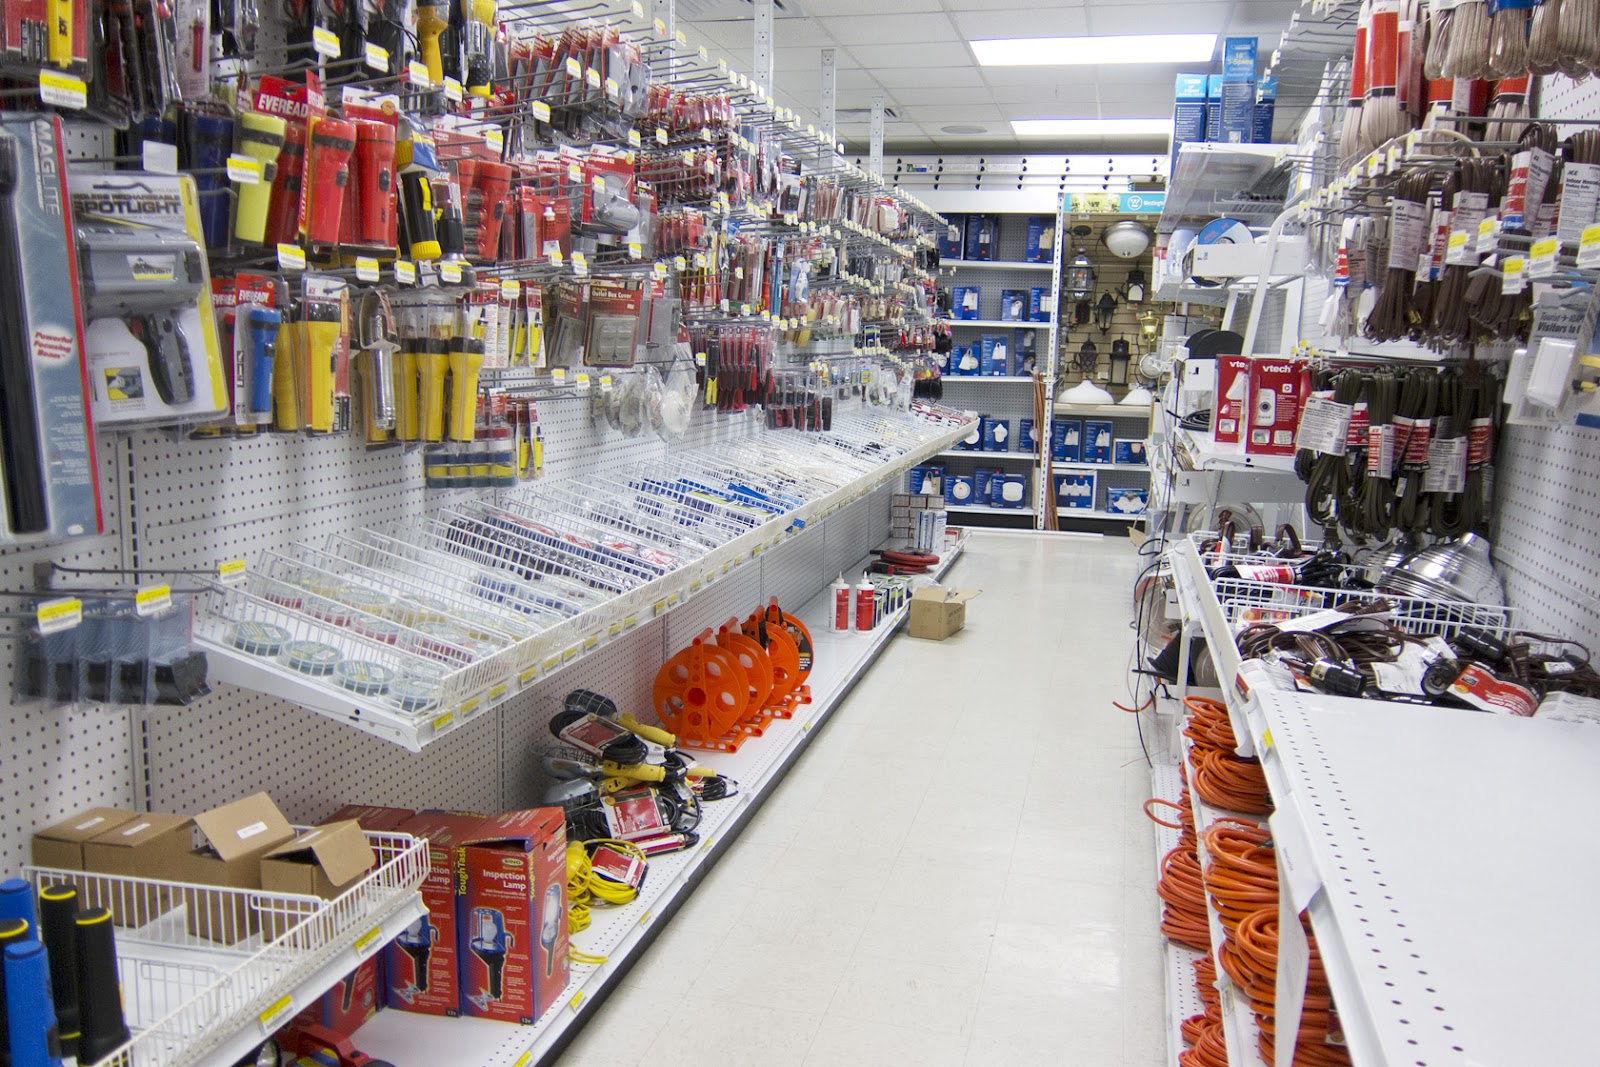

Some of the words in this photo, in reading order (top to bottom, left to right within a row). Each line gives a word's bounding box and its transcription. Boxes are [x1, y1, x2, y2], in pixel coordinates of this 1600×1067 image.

[258, 93, 309, 117] EVEREAD
[37, 120, 60, 216] MAGLITE
[75, 200, 182, 214] SPOTLIGHT
[213, 293, 236, 304] EVEREA
[239, 289, 269, 303] EVEREADY
[1538, 321, 1566, 333] Visitors
[34, 331, 74, 344] Powerful
[33, 340, 72, 353] Focusing
[1262, 364, 1292, 373] vtech
[457, 847, 468, 895] ToughTask
[483, 869, 526, 883] Inspection
[428, 875, 450, 885] Lamp
[503, 880, 526, 892] Lamp
